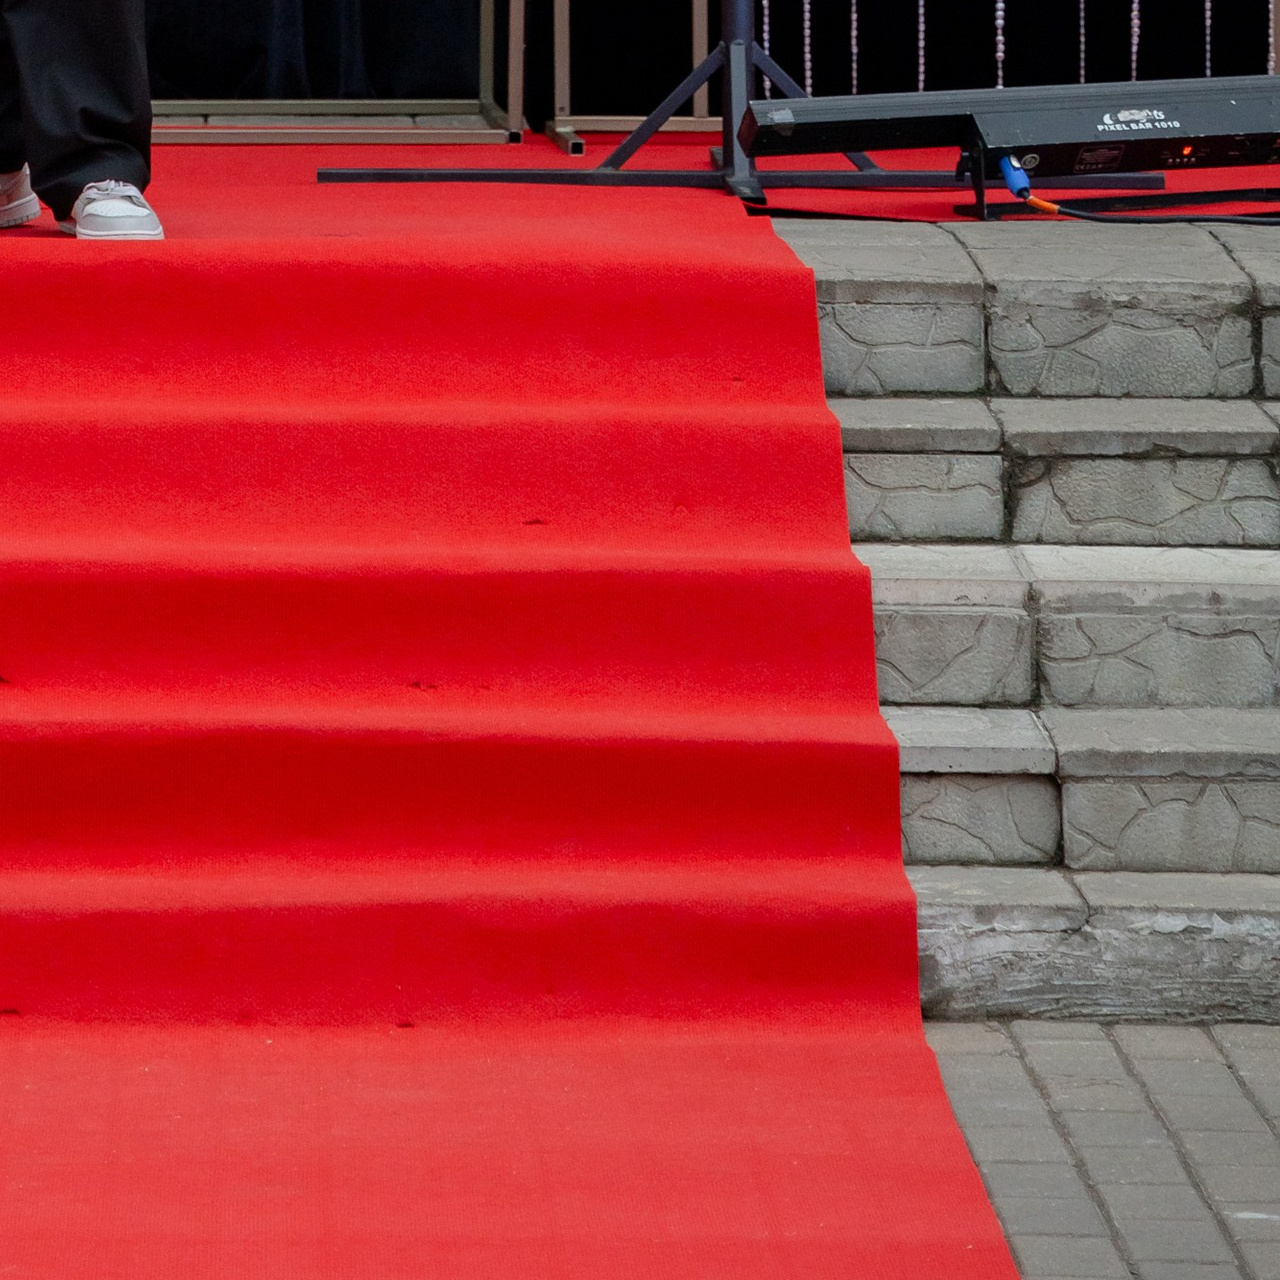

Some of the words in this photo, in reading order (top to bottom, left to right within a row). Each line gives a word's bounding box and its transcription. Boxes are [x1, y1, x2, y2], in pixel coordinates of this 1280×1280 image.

[1097, 122, 1129, 132] PIXEL
[1131, 121, 1153, 131] BAR
[1154, 120, 1181, 129] 1010
